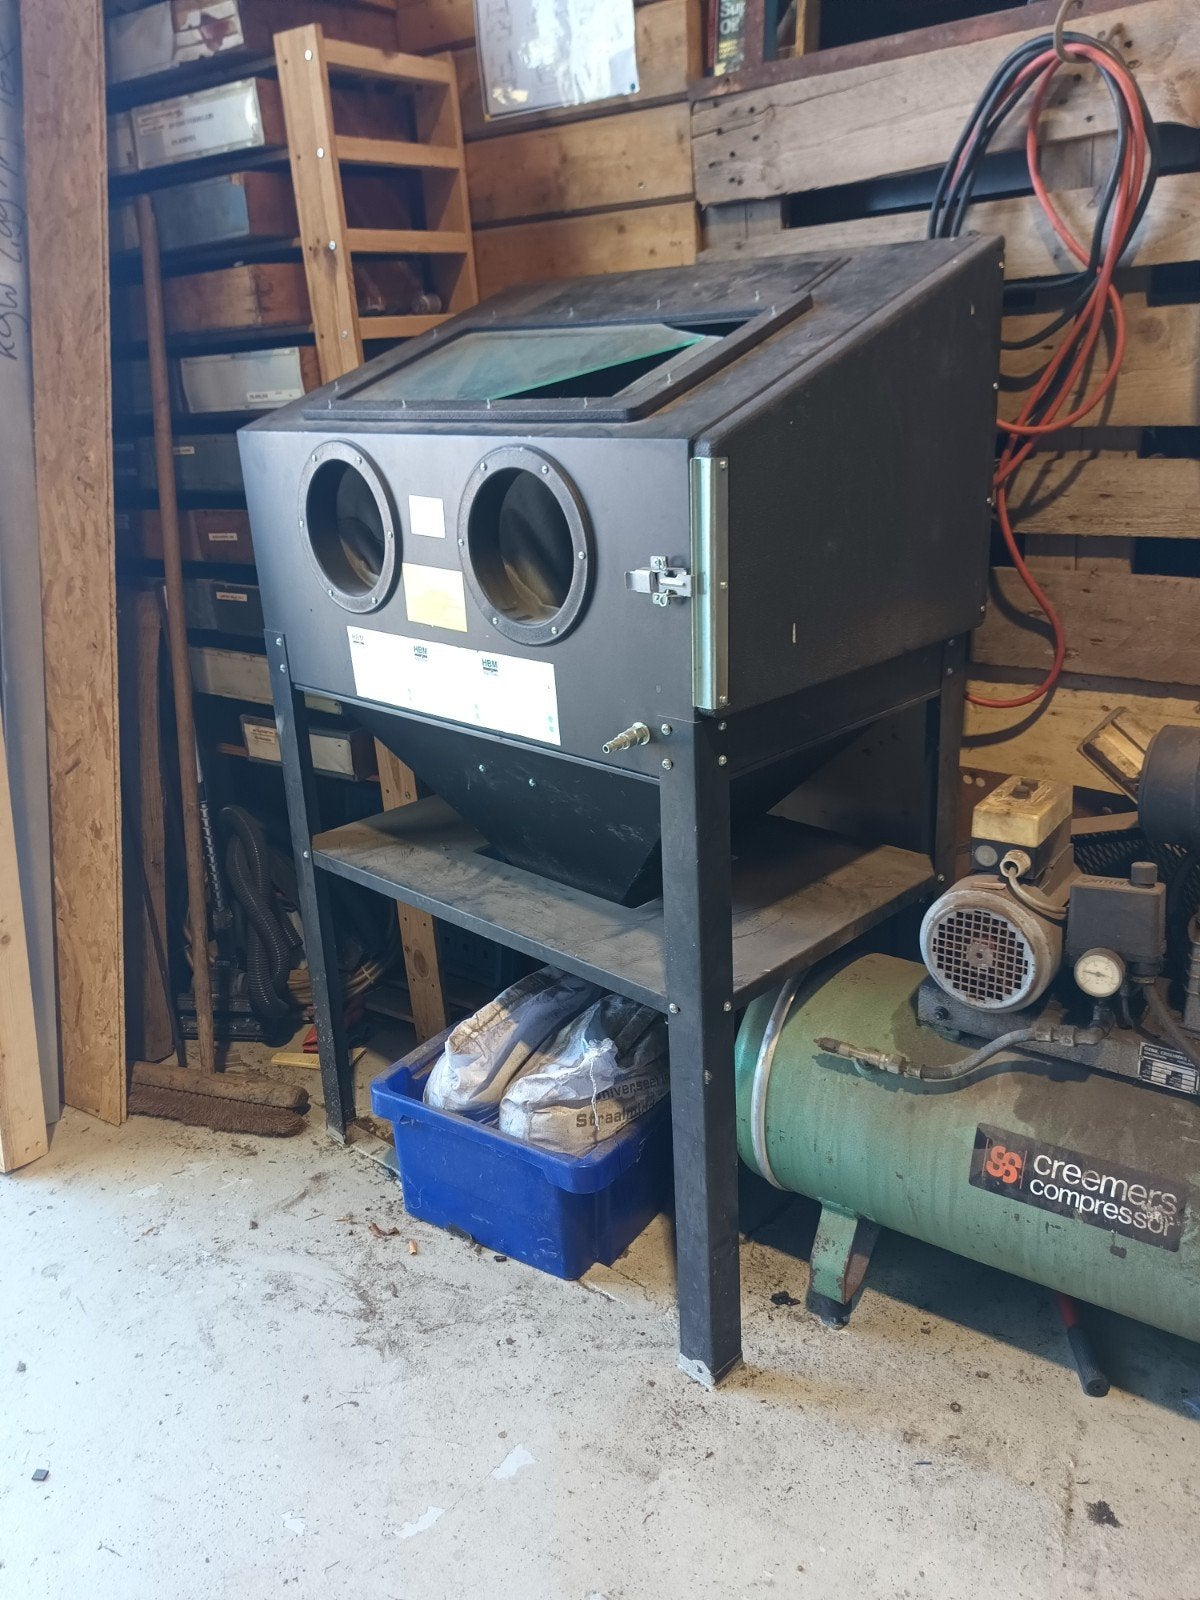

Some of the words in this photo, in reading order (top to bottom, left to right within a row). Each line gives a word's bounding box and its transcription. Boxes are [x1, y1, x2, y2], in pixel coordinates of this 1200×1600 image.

[481, 658, 498, 669] HBM
[1029, 1178, 1174, 1236] compressor
[1032, 1154, 1178, 1215] creemers
